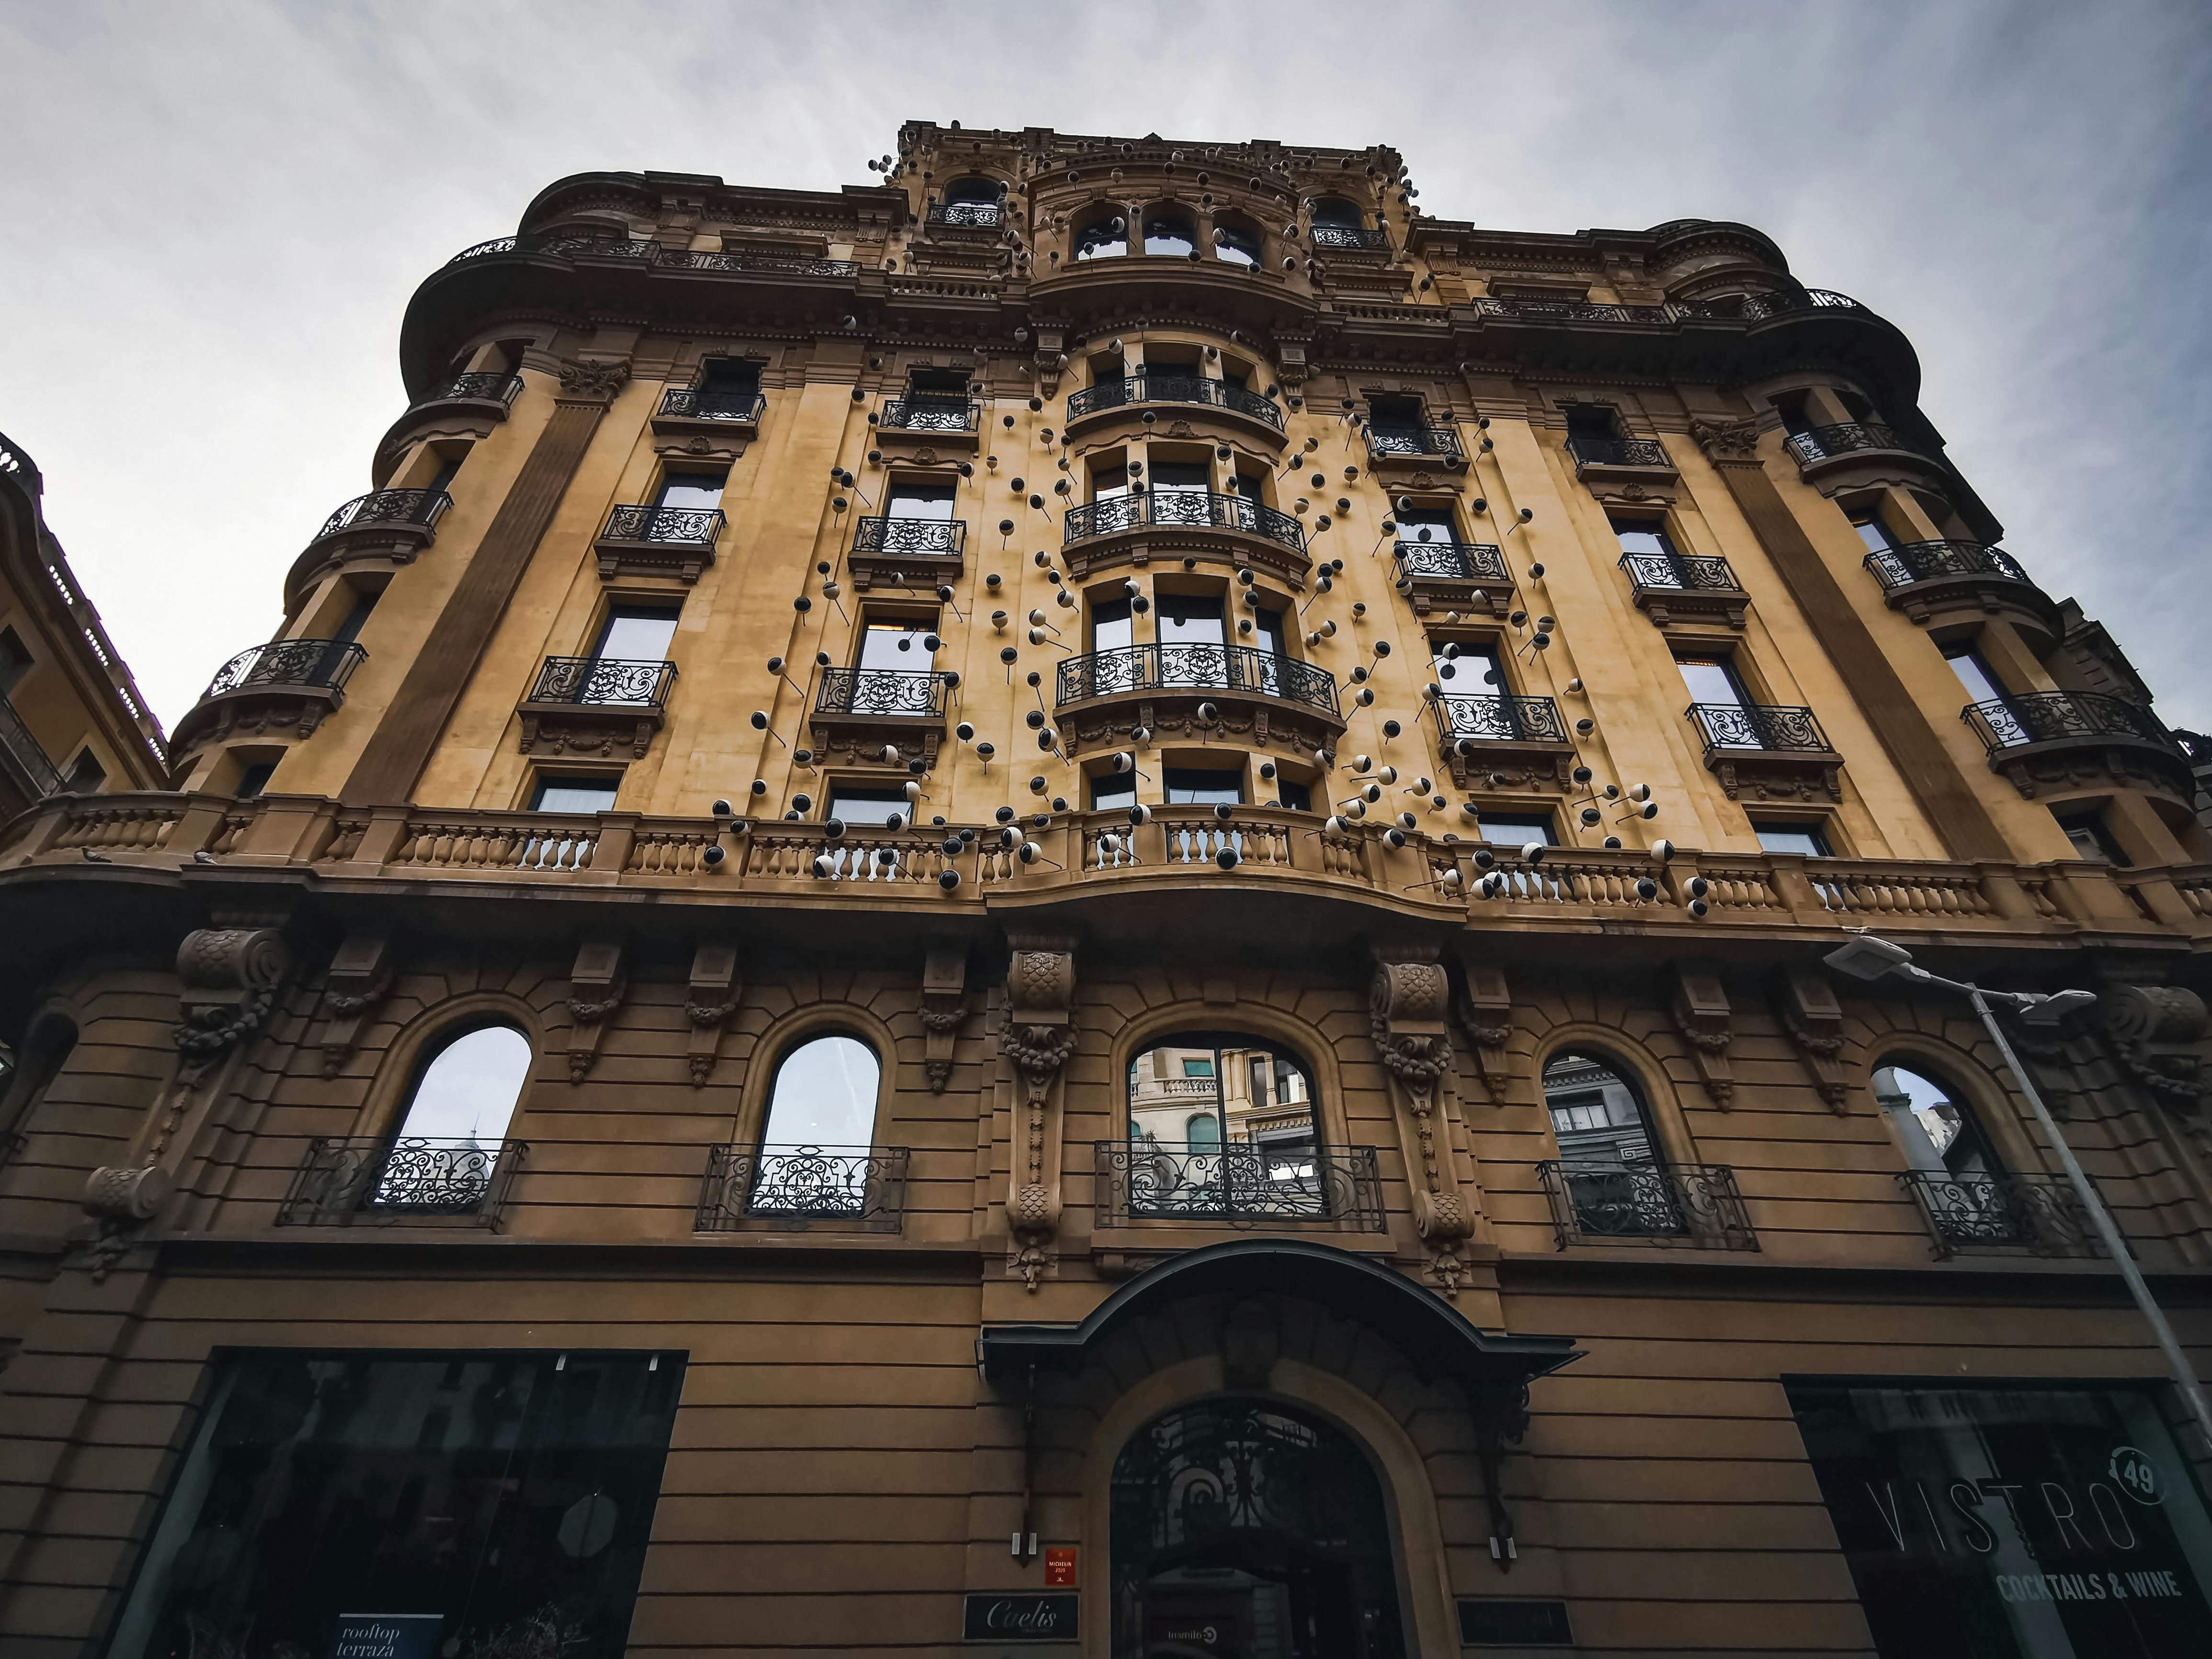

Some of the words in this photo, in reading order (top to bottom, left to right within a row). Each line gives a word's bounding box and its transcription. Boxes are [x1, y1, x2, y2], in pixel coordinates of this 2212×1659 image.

[1866, 1482, 2136, 1558] VISTRO
[2123, 1460, 2155, 1495] 49
[1995, 1571, 2107, 1602] COCKTAILS
[2108, 1572, 2128, 1598] &
[2125, 1570, 2182, 1598] WINE
[987, 1600, 1057, 1628] Caelis
[342, 1623, 400, 1645] rooftop
[336, 1642, 394, 1657] terraza
